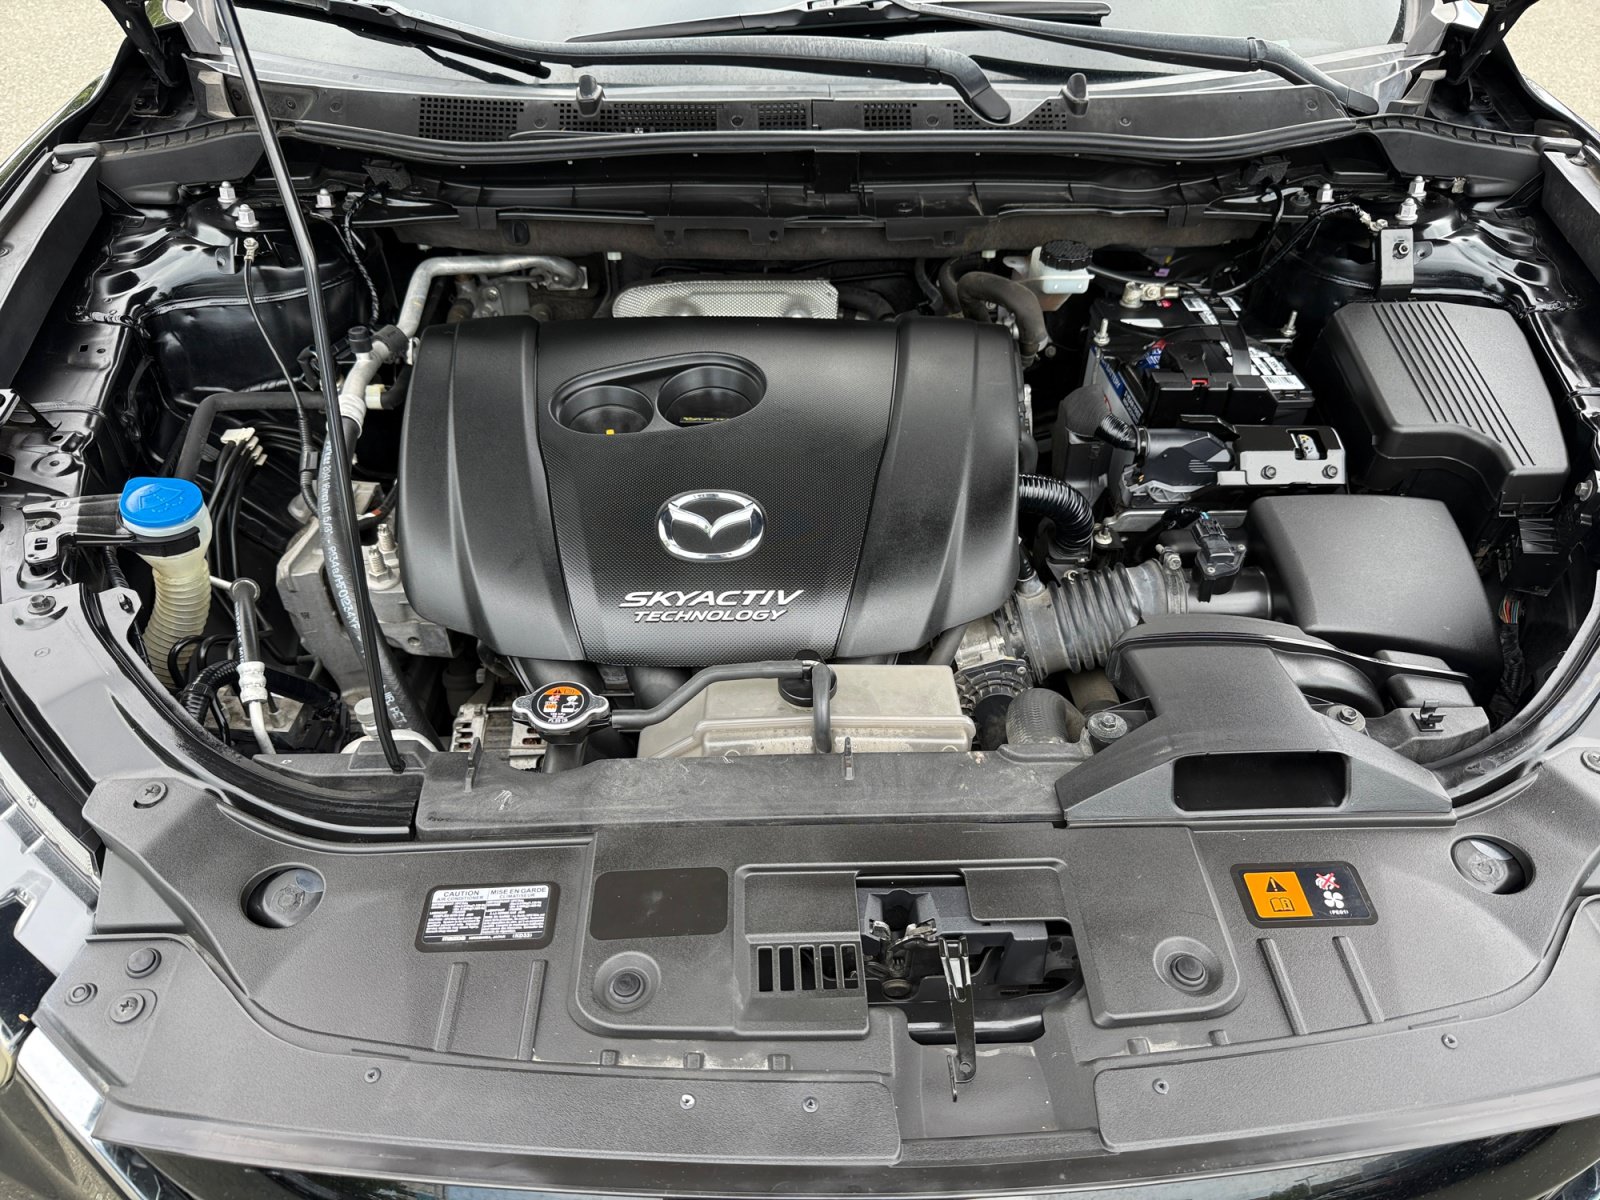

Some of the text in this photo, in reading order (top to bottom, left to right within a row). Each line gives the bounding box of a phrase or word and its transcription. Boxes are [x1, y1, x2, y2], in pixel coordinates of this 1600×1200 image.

[618, 589, 804, 608] SKYACTIV
[634, 610, 788, 623] TECHNOLOGY
[443, 890, 480, 898] CAUTION
